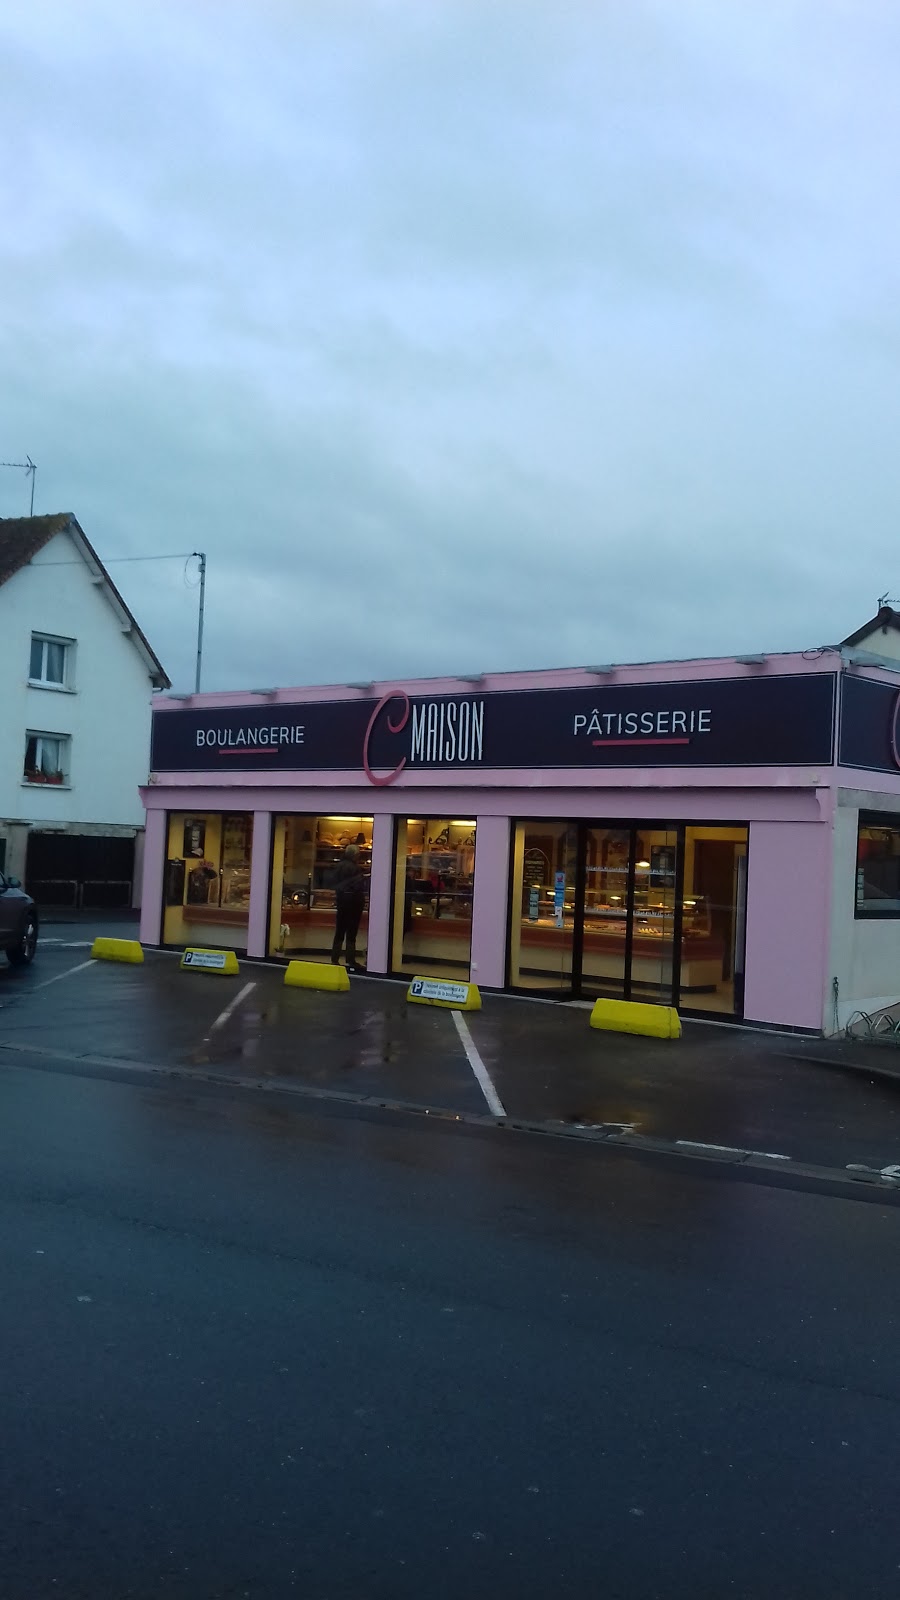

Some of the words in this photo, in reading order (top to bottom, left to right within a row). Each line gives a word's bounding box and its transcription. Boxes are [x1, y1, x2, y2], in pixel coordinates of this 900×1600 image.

[411, 701, 484, 762] MAISON
[573, 708, 712, 735] PÂTISSERIE
[196, 726, 305, 746] BOULANGERIE
[413, 981, 421, 993] P
